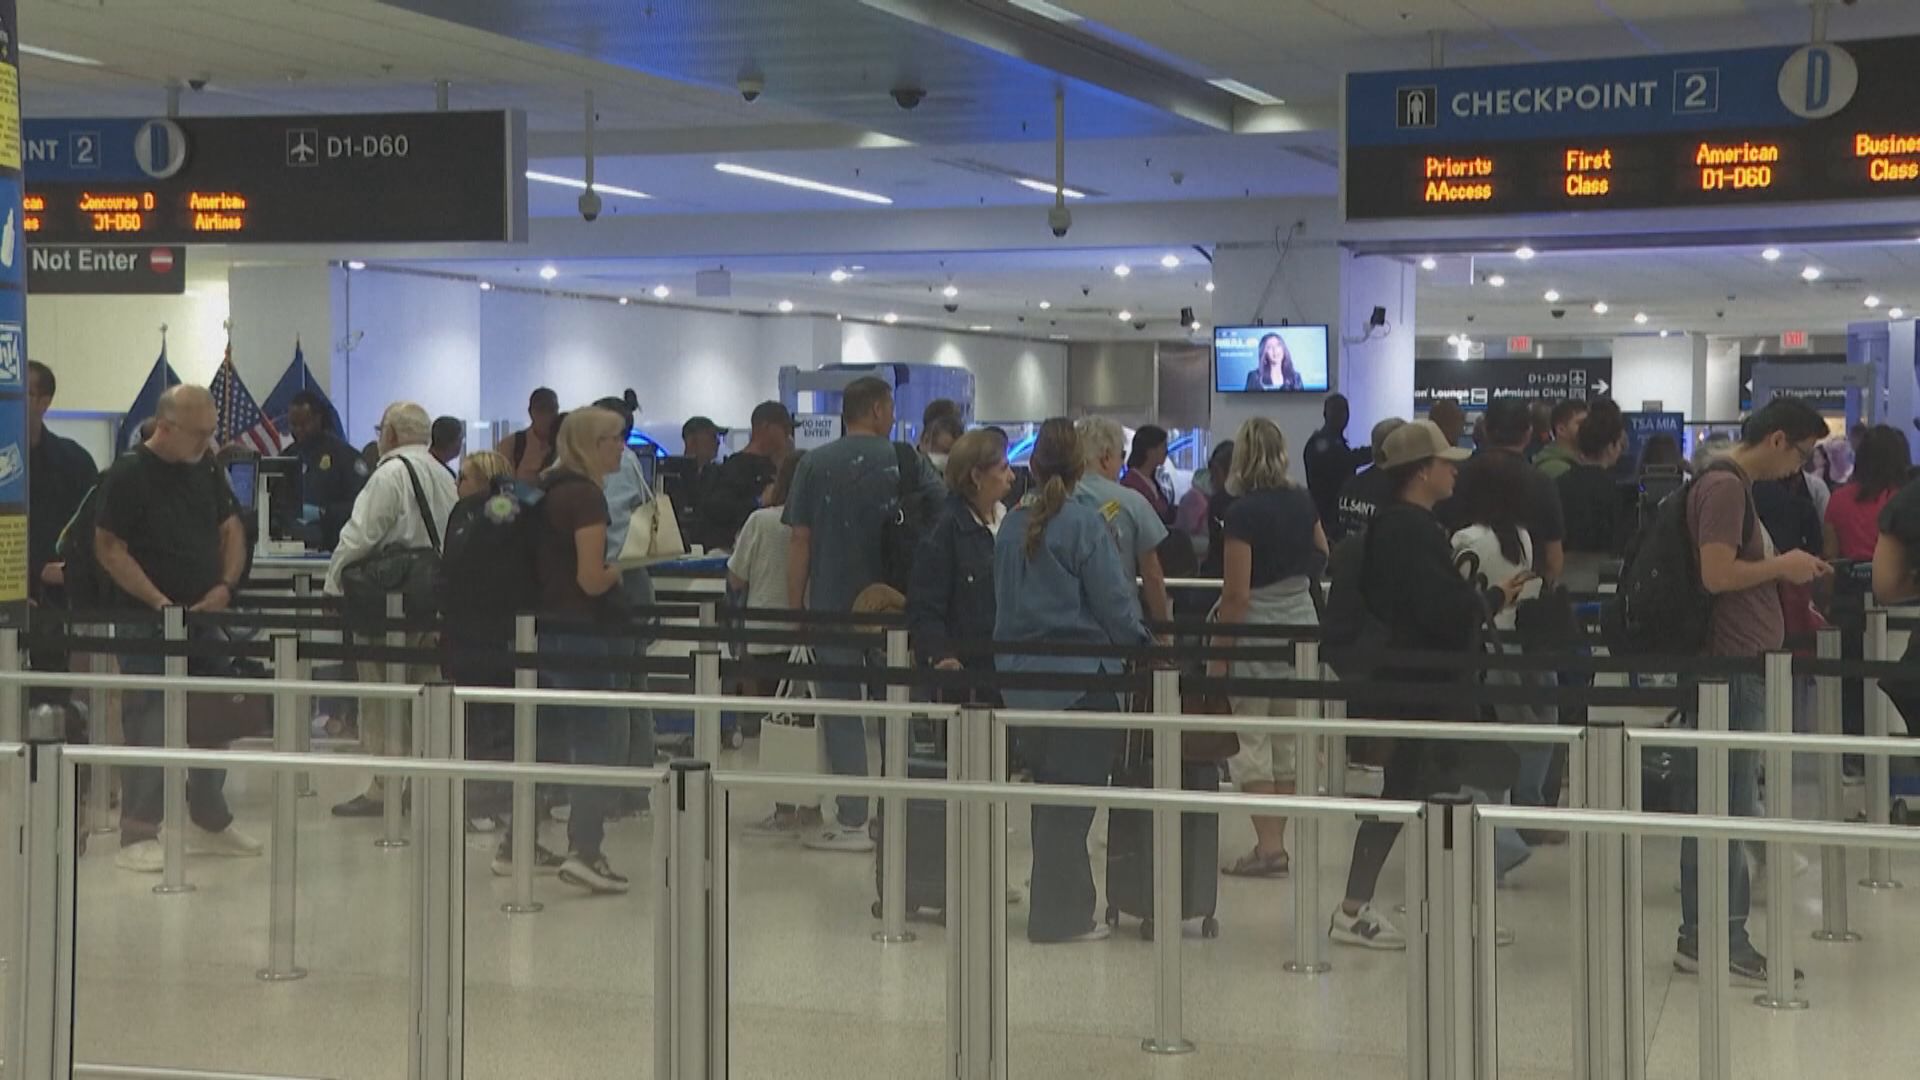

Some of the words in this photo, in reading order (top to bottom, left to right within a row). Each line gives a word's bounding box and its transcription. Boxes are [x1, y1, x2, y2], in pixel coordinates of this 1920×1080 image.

[1806, 50, 1831, 111] D
[1451, 81, 1659, 117] CHECKPOINT
[1684, 74, 1708, 107] 2
[77, 135, 94, 164] 2
[327, 134, 409, 158] D1-D60
[1696, 142, 1779, 165] American
[1426, 157, 1492, 177] Priority
[1566, 150, 1612, 172] First
[1869, 158, 1919, 181] Class
[1566, 174, 1609, 196] Class
[1702, 166, 1771, 190] D1-D60
[143, 192, 155, 210] D
[190, 192, 246, 210] American
[1425, 181, 1492, 201] AAccess
[194, 213, 242, 231] Airlines
[32, 249, 72, 271] Not
[78, 249, 139, 271] Enter
[1656, 416, 1678, 431] MIA
